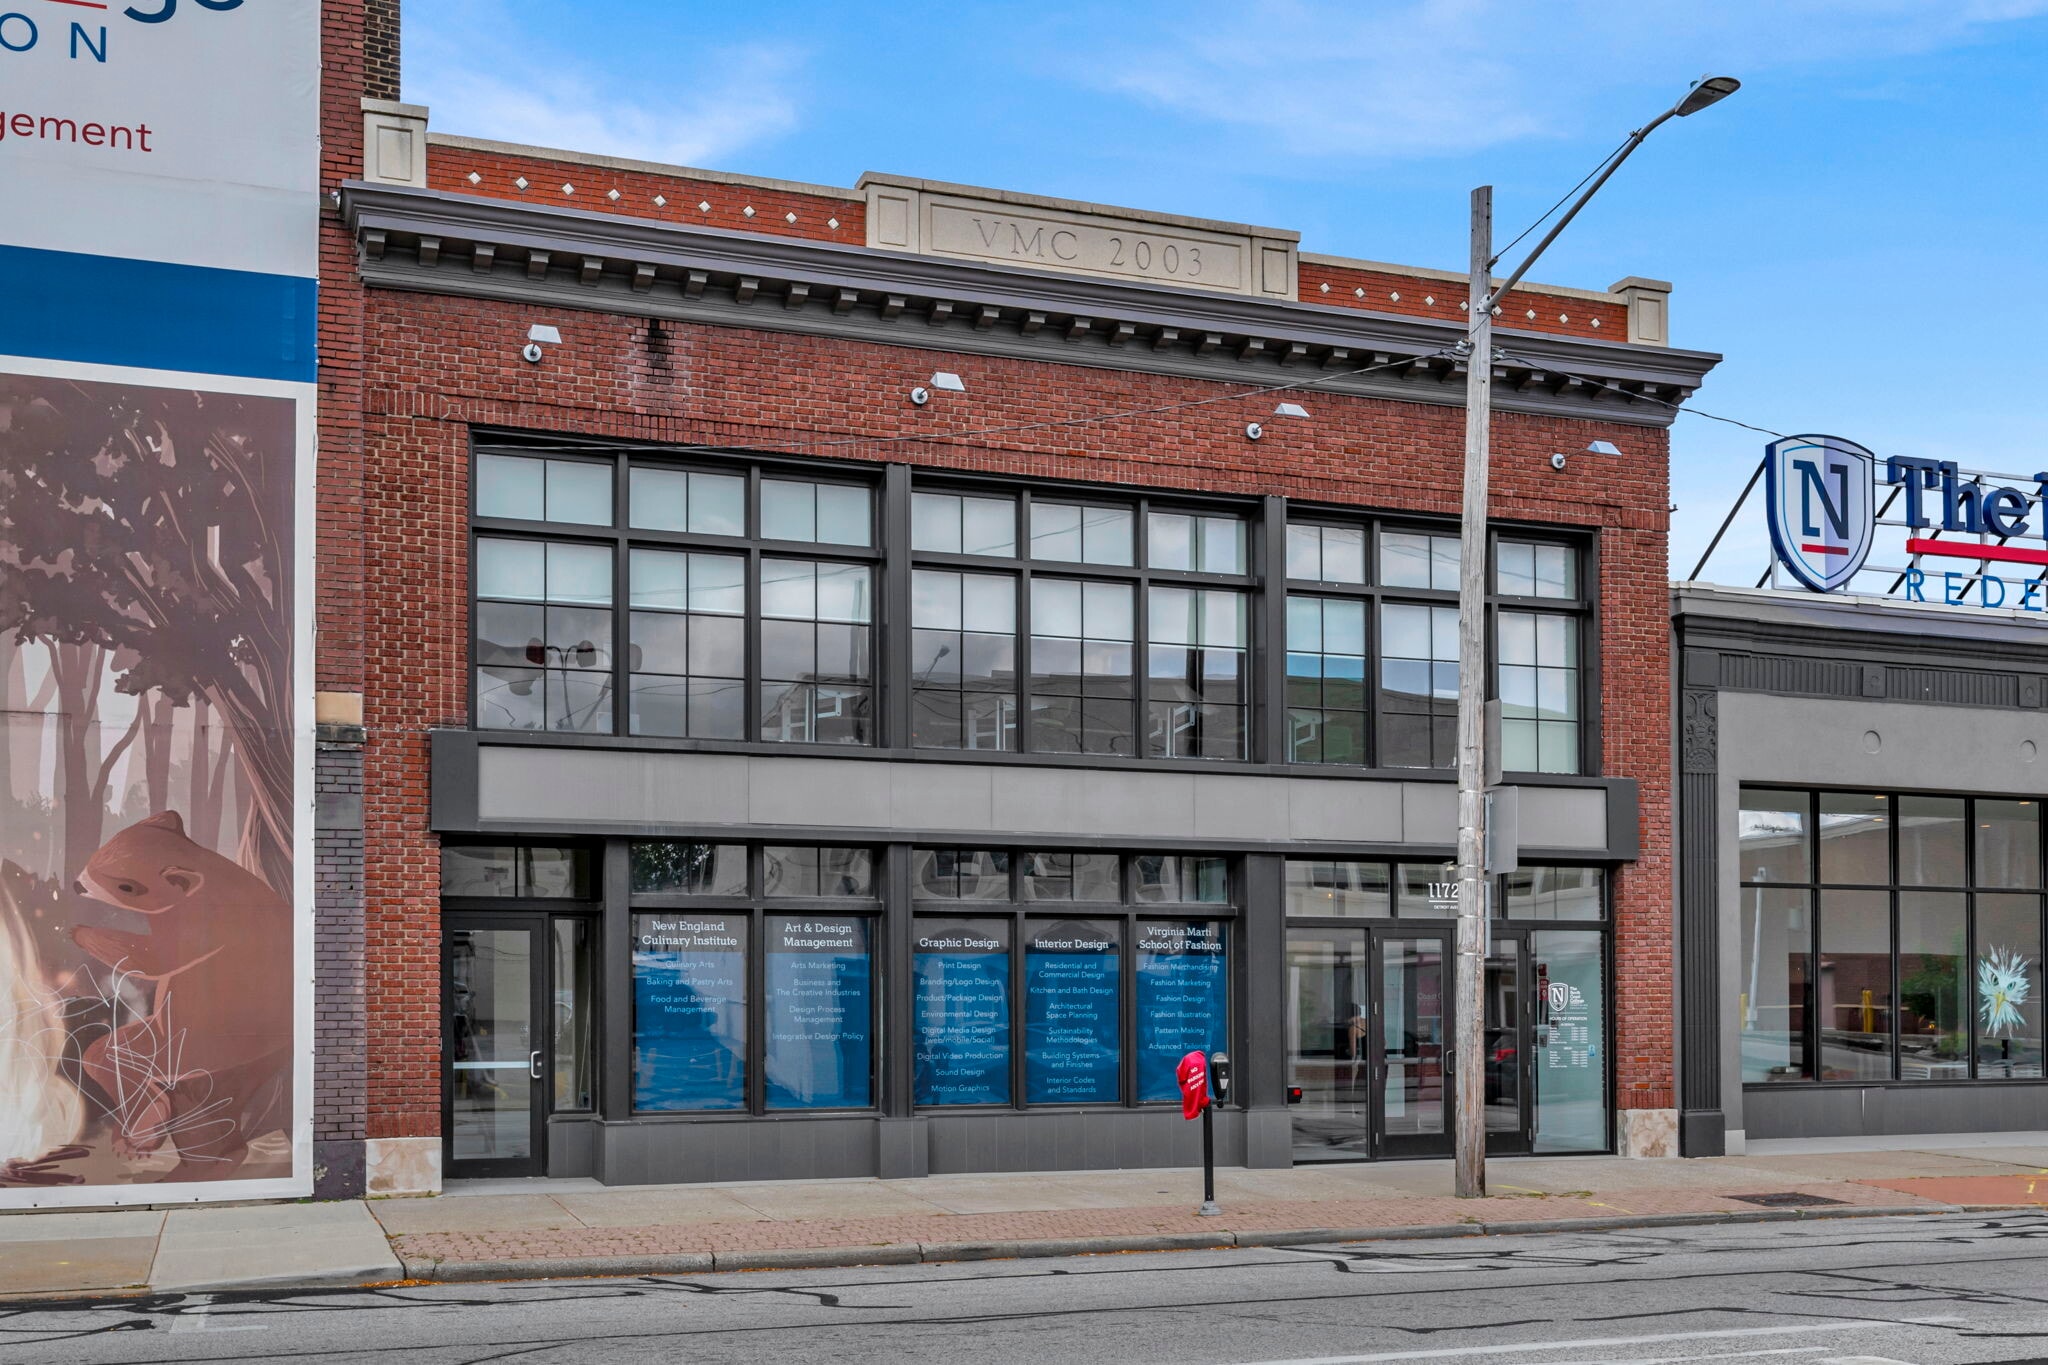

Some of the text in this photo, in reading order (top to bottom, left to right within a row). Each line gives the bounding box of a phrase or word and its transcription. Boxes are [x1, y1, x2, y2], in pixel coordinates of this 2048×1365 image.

[0, 111, 152, 152] ement
[972, 218, 1201, 276] VMC 2003
[1887, 455, 2030, 538] The
[652, 921, 725, 933] New England
[785, 923, 852, 935] Art & Design
[1147, 927, 1212, 938] Virginia Marti
[642, 935, 737, 947] Culinary Institute
[784, 938, 853, 949] Management
[919, 938, 999, 950] Graphic Design
[1035, 939, 1109, 951] Interior Design
[1139, 940, 1222, 950] School of Fashion
[666, 961, 697, 969] Culinary
[808, 962, 846, 971] Marketing
[957, 962, 982, 970] Design
[1170, 963, 1218, 972] Merchandising
[1081, 971, 1105, 980] Design
[647, 978, 673, 987] Baking
[692, 978, 714, 987] Pastry
[920, 978, 1000, 987] Branding/Logo Design
[1178, 979, 1211, 988] Marketing
[1090, 987, 1113, 996] Design
[690, 995, 726, 1004] Beverage
[916, 994, 1003, 1003] Product/Package Design
[1183, 995, 1206, 1004] Design
[665, 1006, 715, 1014] Management
[789, 1006, 815, 1014] Design
[974, 1010, 998, 1019] Design
[794, 1016, 843, 1024] Management
[1046, 1012, 1098, 1020] Space Planning
[922, 1027, 946, 1035] Digital
[971, 1027, 996, 1035] Design
[1180, 1027, 1204, 1036] Making
[773, 1033, 864, 1042] Integrative Design Policy
[917, 1052, 941, 1062] Digital
[1042, 1052, 1070, 1060] Building
[961, 1069, 985, 1077] Design
[958, 1085, 990, 1094] Graphics
